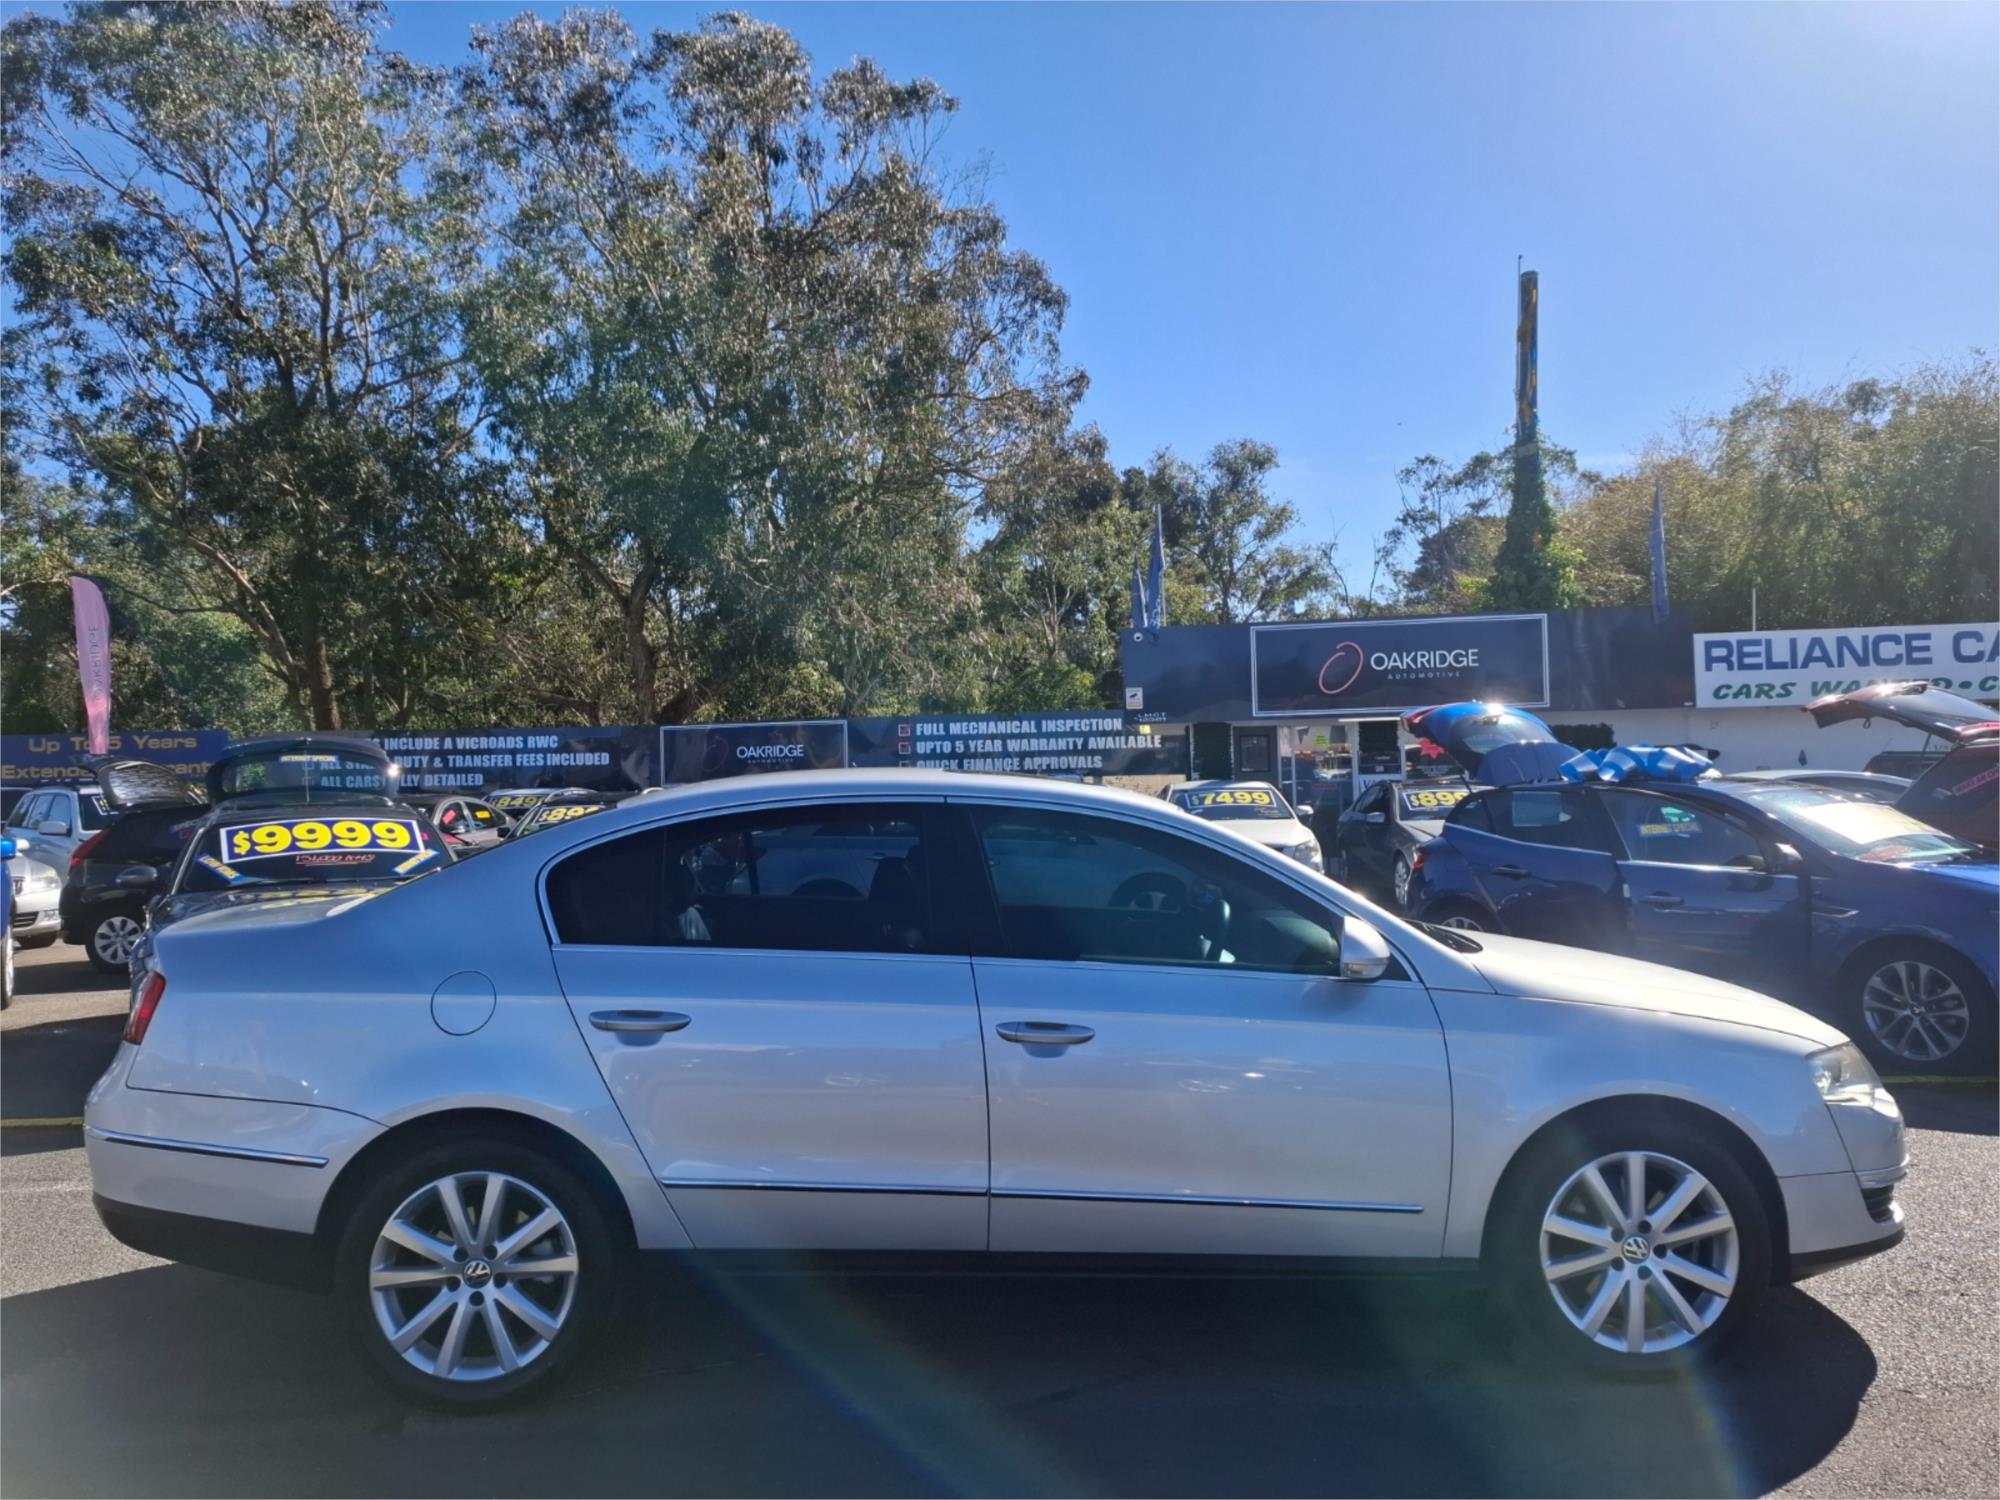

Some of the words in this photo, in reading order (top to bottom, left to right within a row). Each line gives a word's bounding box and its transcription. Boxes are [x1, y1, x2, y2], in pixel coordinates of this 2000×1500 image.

[1370, 649, 1480, 671] OAKRIDGE
[1704, 632, 1933, 672] RELIANCE
[1387, 671, 1461, 680] AUTOMOTIVE
[1712, 681, 1797, 700] CARS
[916, 722, 946, 736] FULL
[949, 720, 1038, 735] MECHANICAL
[1041, 718, 1123, 733] INSPECTION
[29, 737, 61, 754] Up
[132, 735, 198, 750] Years
[384, 737, 440, 751] INCLUDE
[443, 737, 452, 750] A
[455, 736, 524, 750] VICROADS
[527, 735, 559, 749] RWC
[955, 740, 965, 753] 5
[969, 739, 1003, 753] YEAR
[1006, 737, 1084, 752] WARRANTY
[1088, 735, 1162, 749] AVAILABLE
[736, 744, 805, 759] OAKRIDGE
[433, 756, 443, 768] &
[447, 754, 513, 768] TRANSFER
[516, 753, 544, 767] FEES
[547, 752, 610, 766] INCLUDED
[1024, 756, 1103, 770] APPROVALS
[1, 764, 97, 779] Extende
[320, 776, 342, 788] ALL
[346, 775, 381, 789] CARS
[424, 773, 484, 787] DETAILED
[1191, 791, 1270, 805] $7499
[233, 820, 411, 855] $9999
